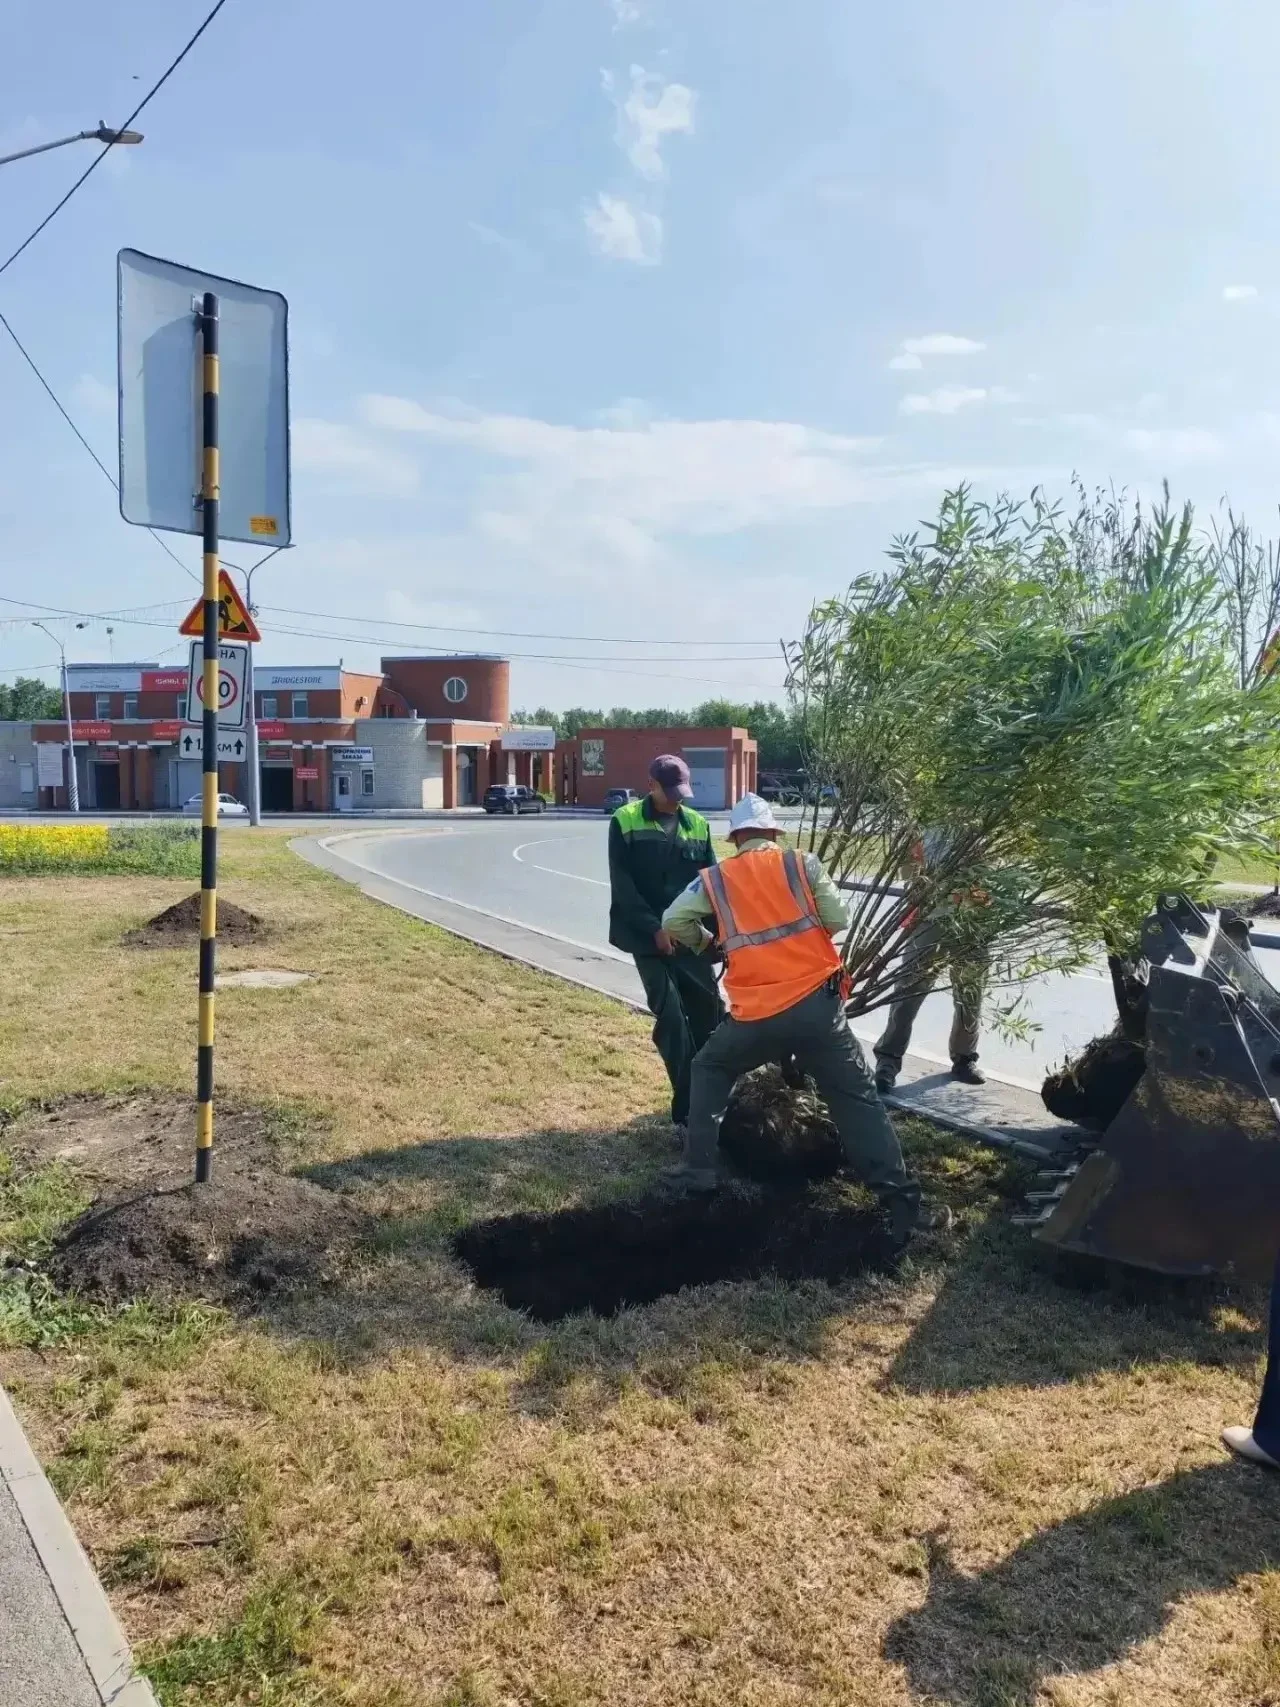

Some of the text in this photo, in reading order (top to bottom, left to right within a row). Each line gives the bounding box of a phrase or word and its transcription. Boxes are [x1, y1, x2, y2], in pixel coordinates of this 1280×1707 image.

[219, 649, 236, 660] НА
[272, 676, 322, 684] BRIDGESTONE
[218, 681, 230, 698] 0
